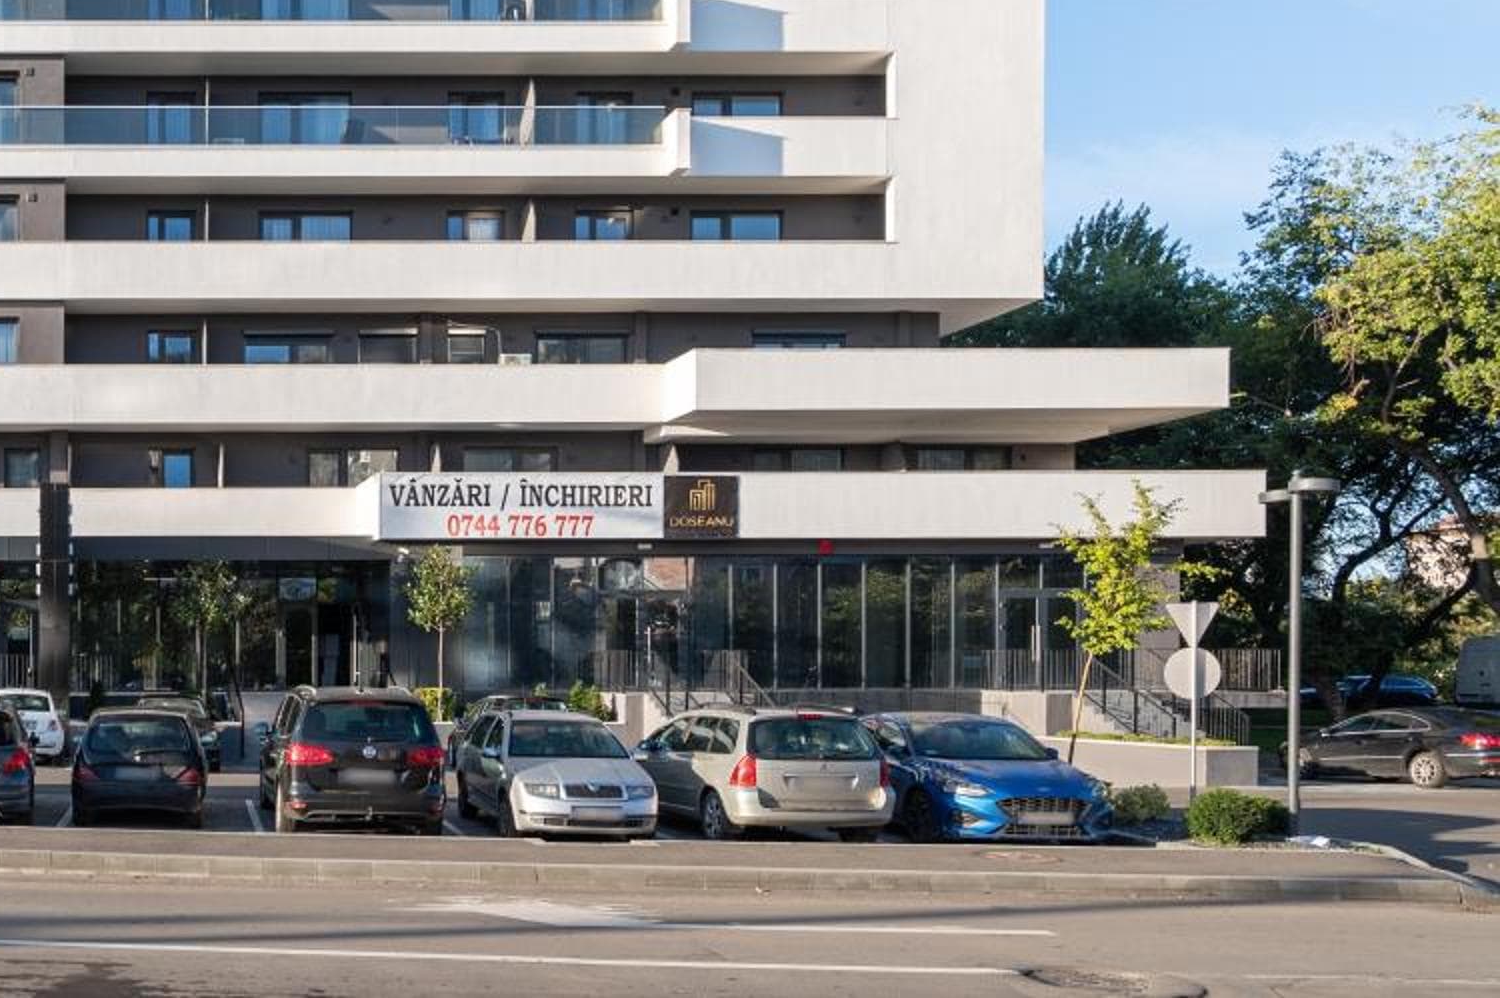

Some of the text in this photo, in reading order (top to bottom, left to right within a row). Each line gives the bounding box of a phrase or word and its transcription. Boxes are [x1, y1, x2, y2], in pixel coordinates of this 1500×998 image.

[389, 477, 653, 511] VÂNZĂRI / ÎNCHIRIERI
[446, 514, 594, 537] 0744 776 777
[669, 516, 734, 528] DOSEANU
